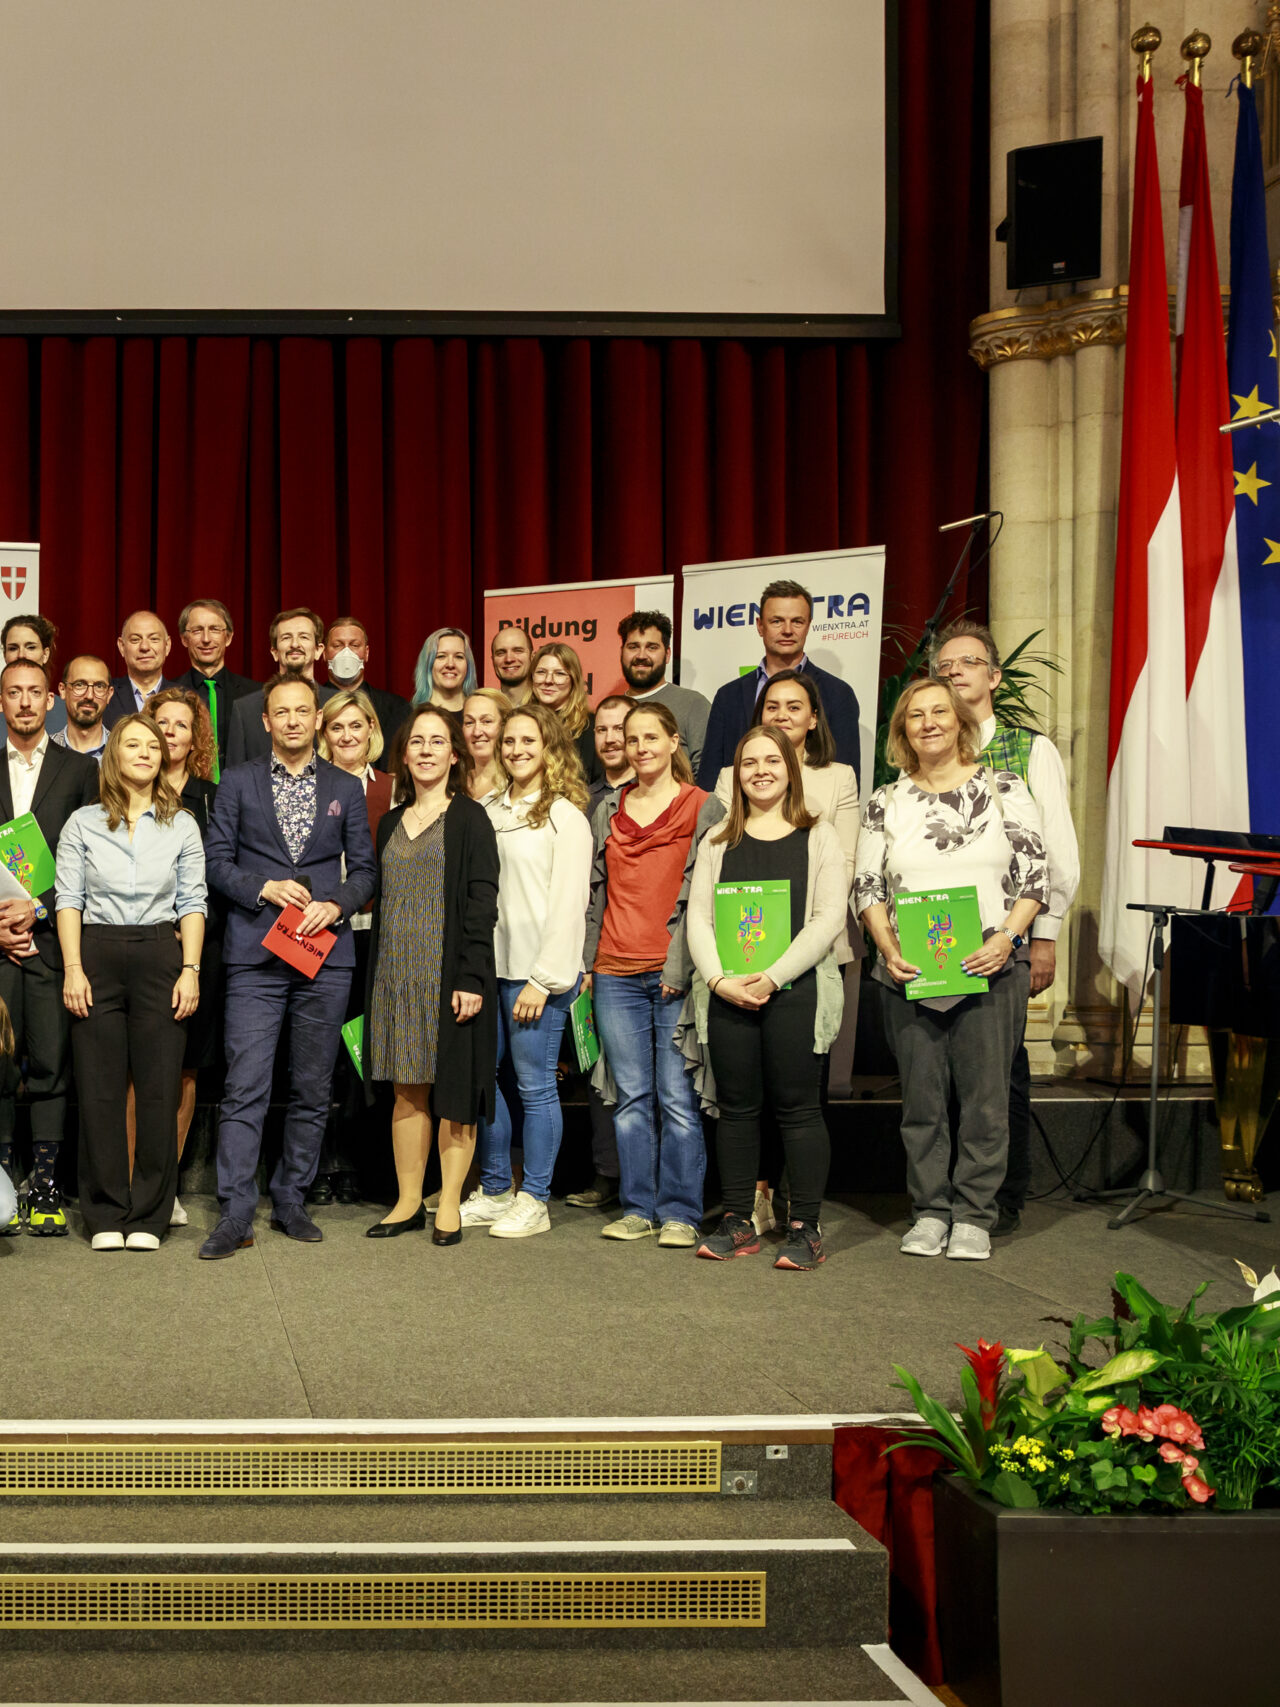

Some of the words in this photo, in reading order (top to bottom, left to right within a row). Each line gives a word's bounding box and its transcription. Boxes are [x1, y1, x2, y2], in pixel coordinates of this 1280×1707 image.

[693, 592, 870, 631] WIENTRA
[812, 619, 870, 632] WIENXTRA.AT
[821, 631, 869, 642] #FÜREUCH
[717, 886, 763, 895] WIENXTRA
[898, 893, 950, 905] WIENXTRA
